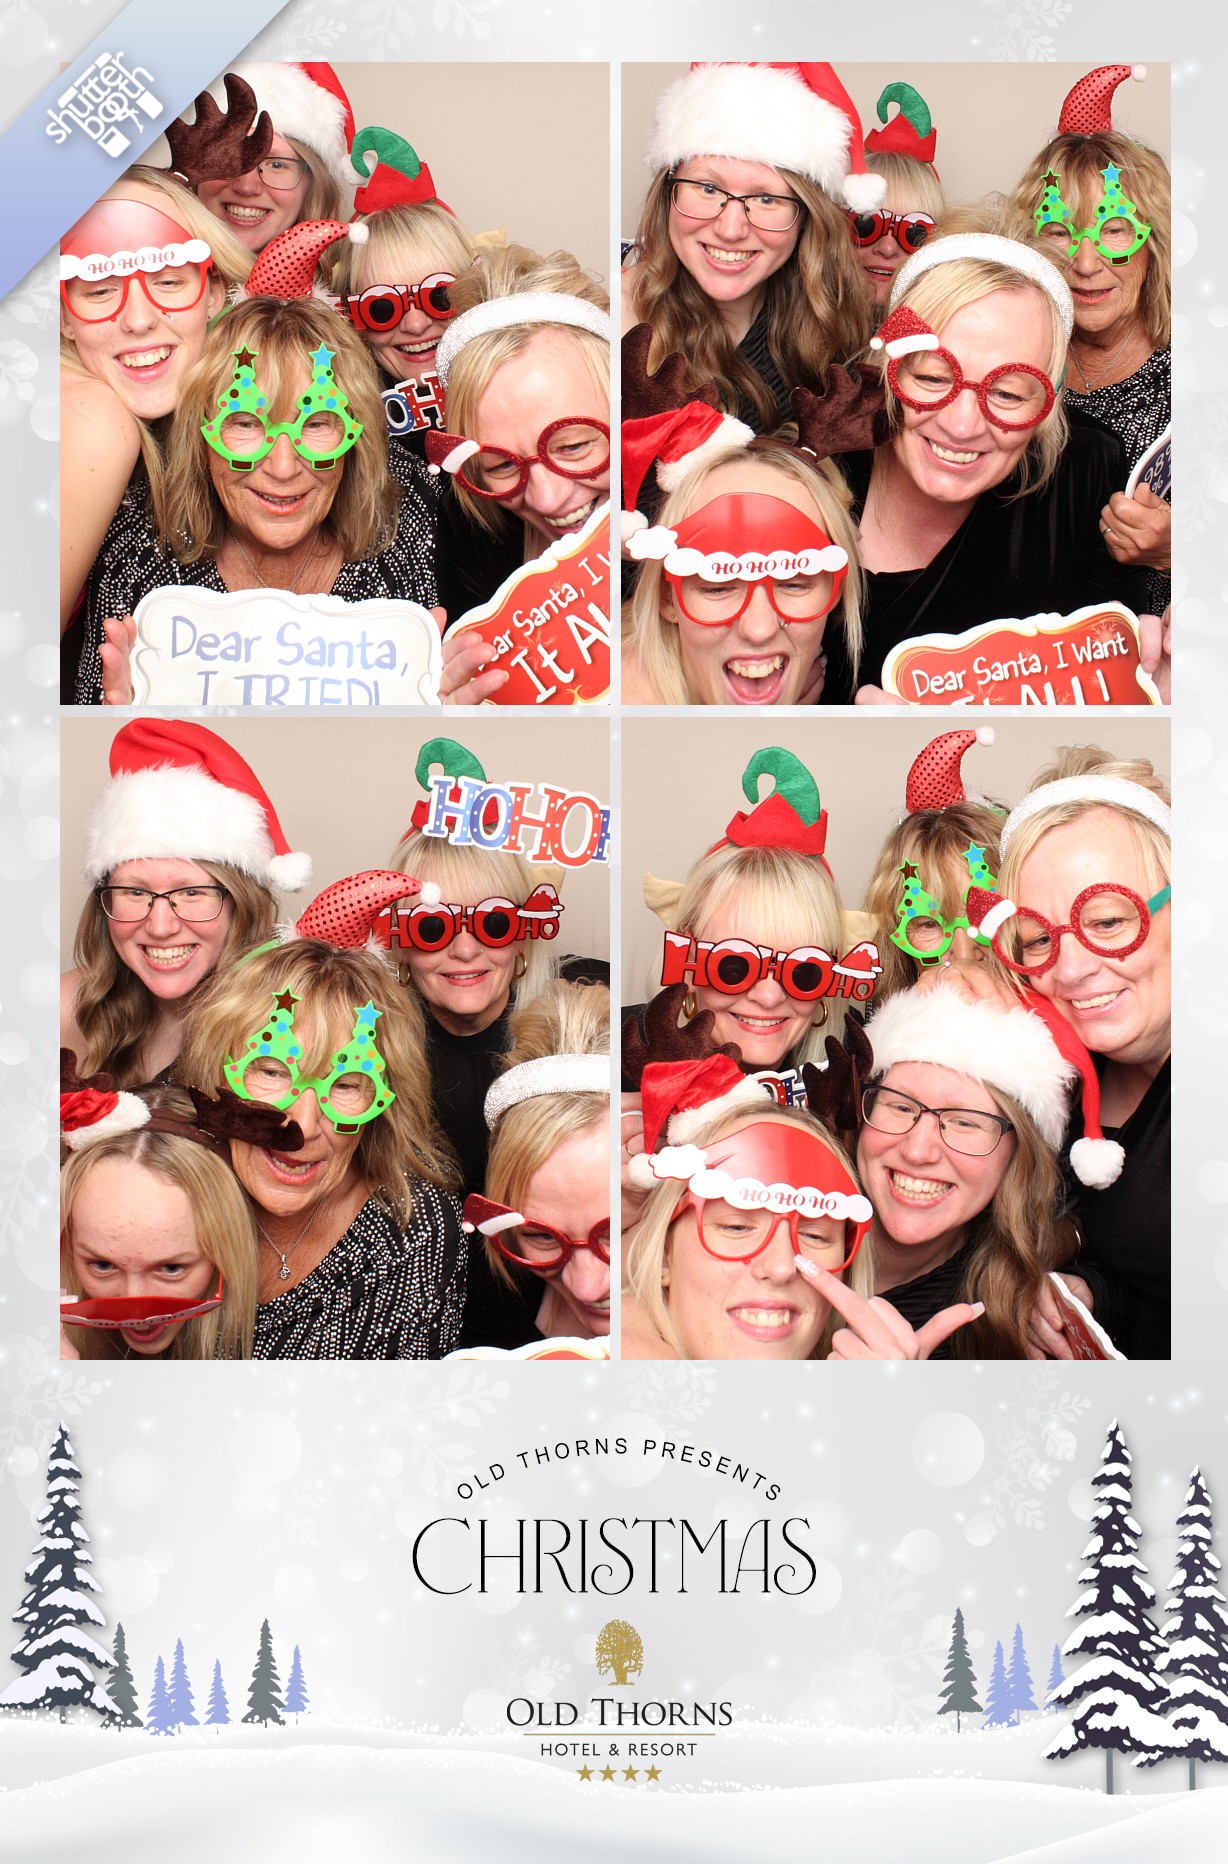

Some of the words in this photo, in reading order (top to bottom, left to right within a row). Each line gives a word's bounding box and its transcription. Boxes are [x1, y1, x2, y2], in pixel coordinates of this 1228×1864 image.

[88, 261, 115, 274] HO
[118, 255, 145, 269] HO
[148, 250, 175, 264] HO
[711, 562, 743, 575] HO
[746, 559, 777, 574] HO
[780, 557, 810, 570] HO
[513, 583, 585, 637] Santa,
[578, 557, 604, 586] I
[171, 615, 262, 664] Dear
[276, 621, 408, 677] Santa,
[510, 643, 575, 704] It
[911, 669, 967, 698] Dear
[972, 652, 1048, 685] Santa,
[1052, 641, 1069, 669] I
[1071, 632, 1129, 665] Want
[660, 930, 875, 1001] HOHOHO
[739, 1187, 771, 1204] HO
[774, 1191, 806, 1207] HO
[809, 1196, 837, 1211] HO
